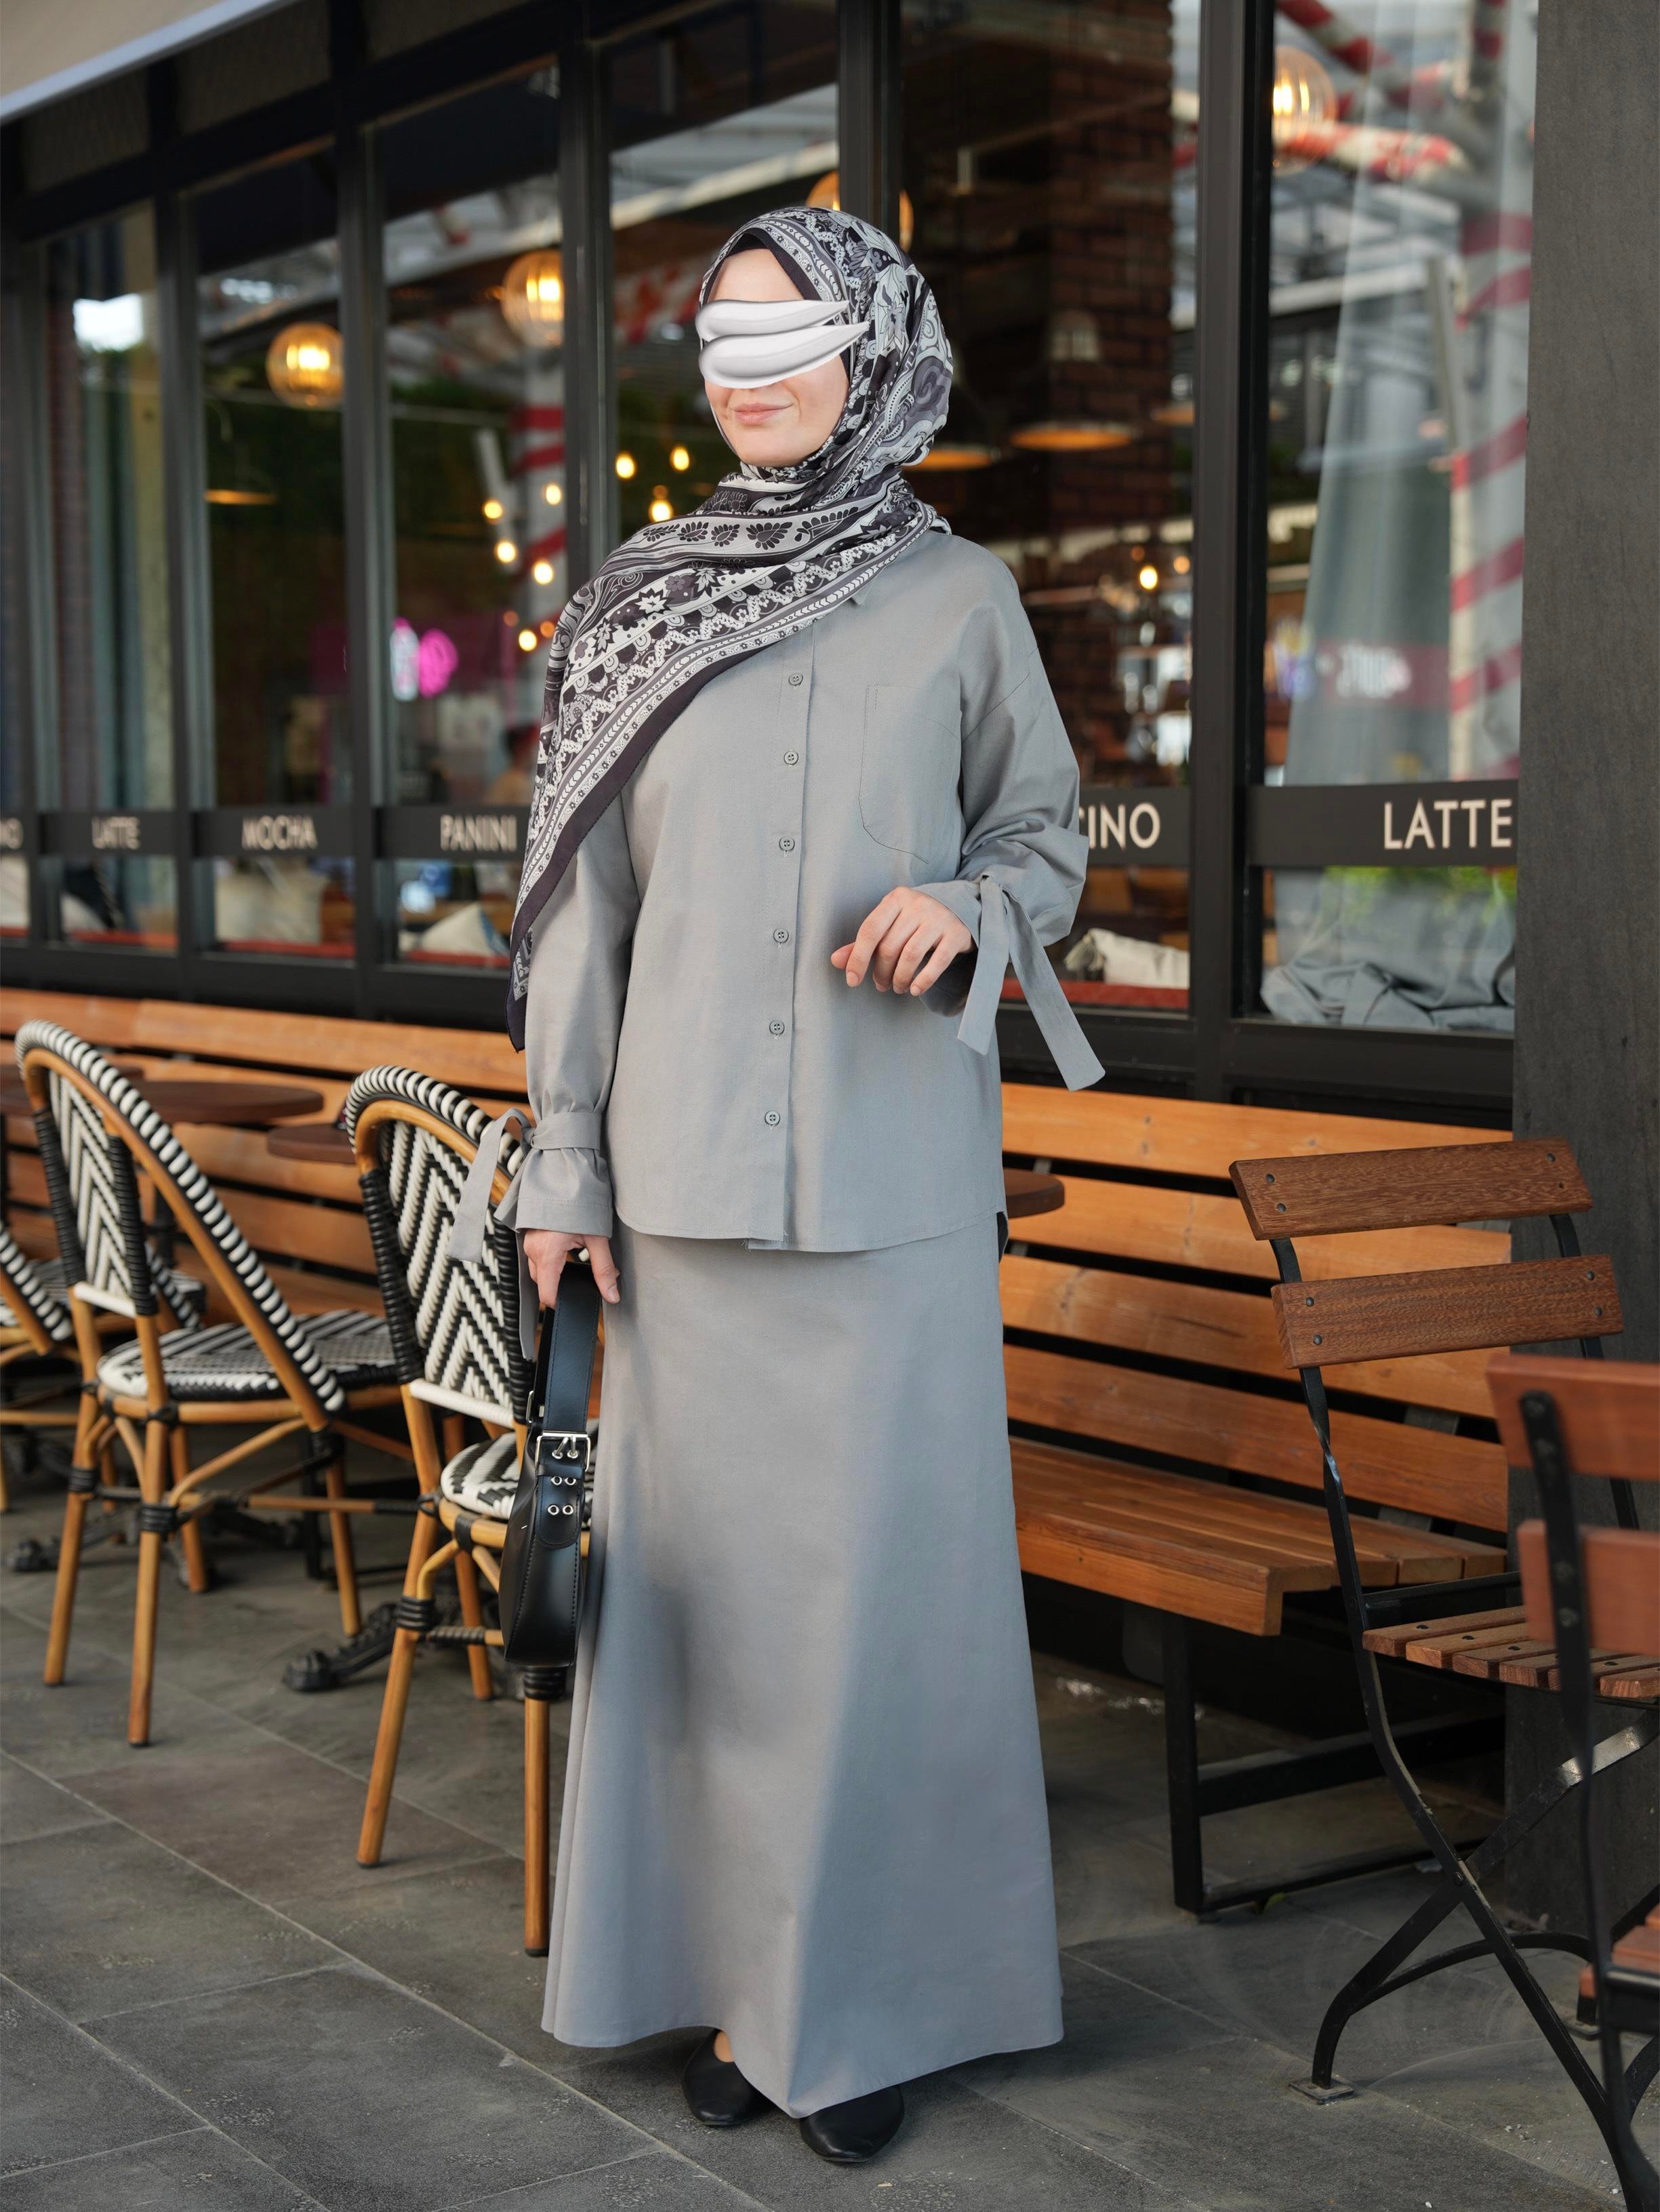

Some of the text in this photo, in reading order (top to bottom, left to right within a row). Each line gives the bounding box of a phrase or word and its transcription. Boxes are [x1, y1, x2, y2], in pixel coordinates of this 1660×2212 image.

[92, 816, 140, 849] LATTE
[241, 815, 318, 850] MOCHA
[441, 814, 517, 851] PANINI
[1079, 802, 1160, 850] INO
[1384, 797, 1512, 849] LATTE
